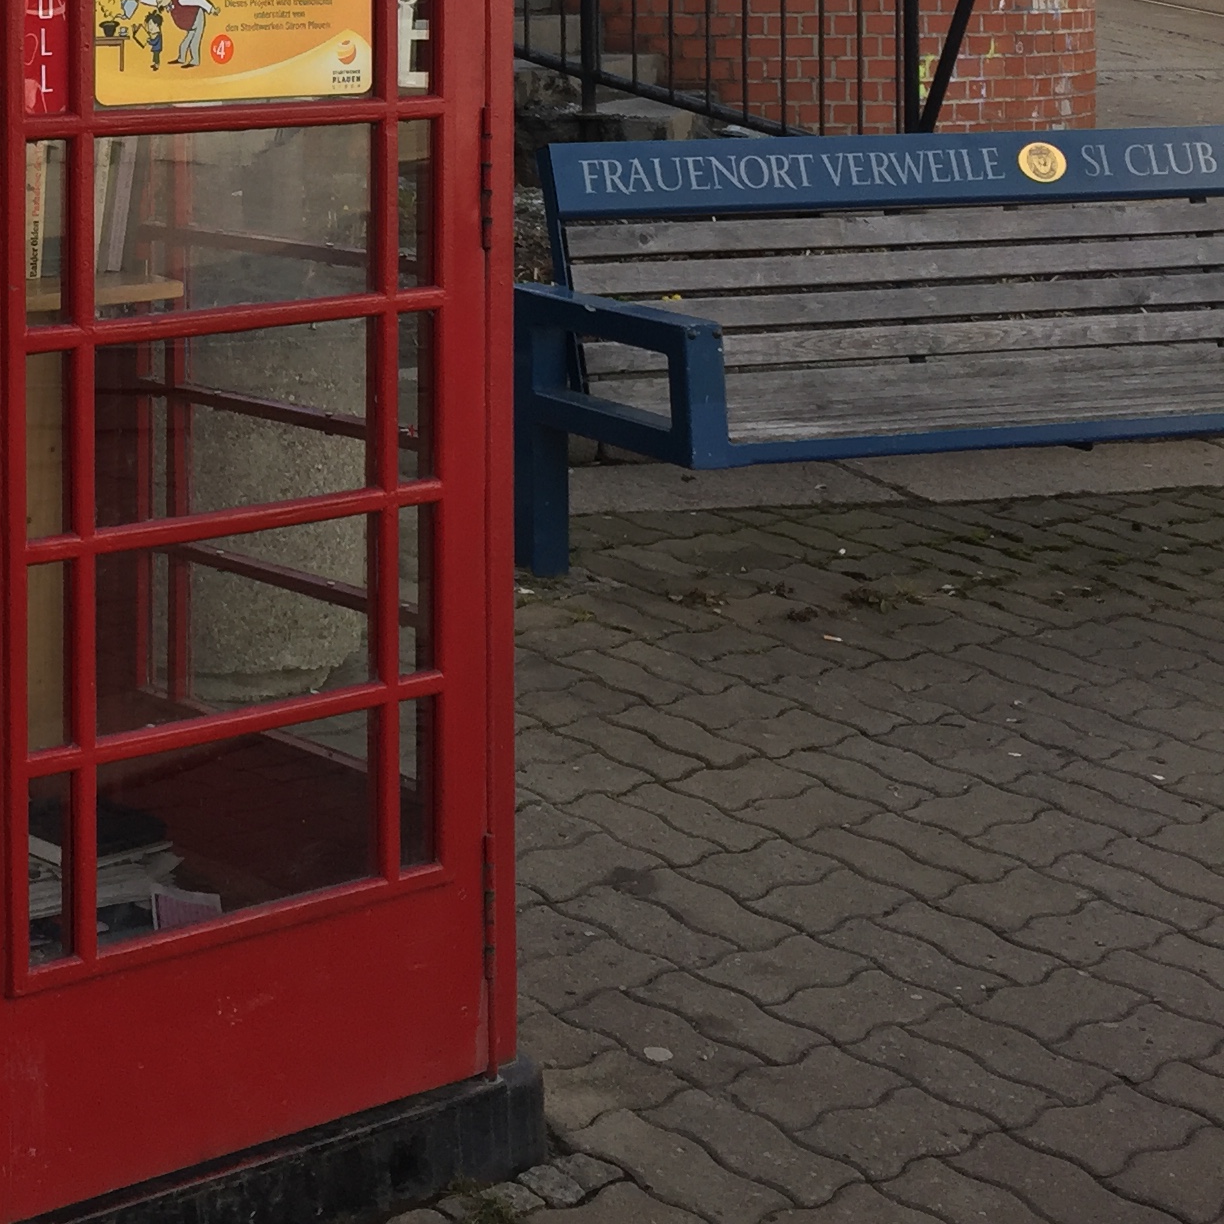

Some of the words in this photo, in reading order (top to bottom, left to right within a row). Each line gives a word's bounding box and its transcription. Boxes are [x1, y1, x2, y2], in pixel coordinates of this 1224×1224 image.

[578, 154, 814, 195] FRAUENORT
[821, 147, 1006, 187] VERWEILE
[1080, 144, 1114, 177] SI
[1124, 141, 1218, 176] CLUB
